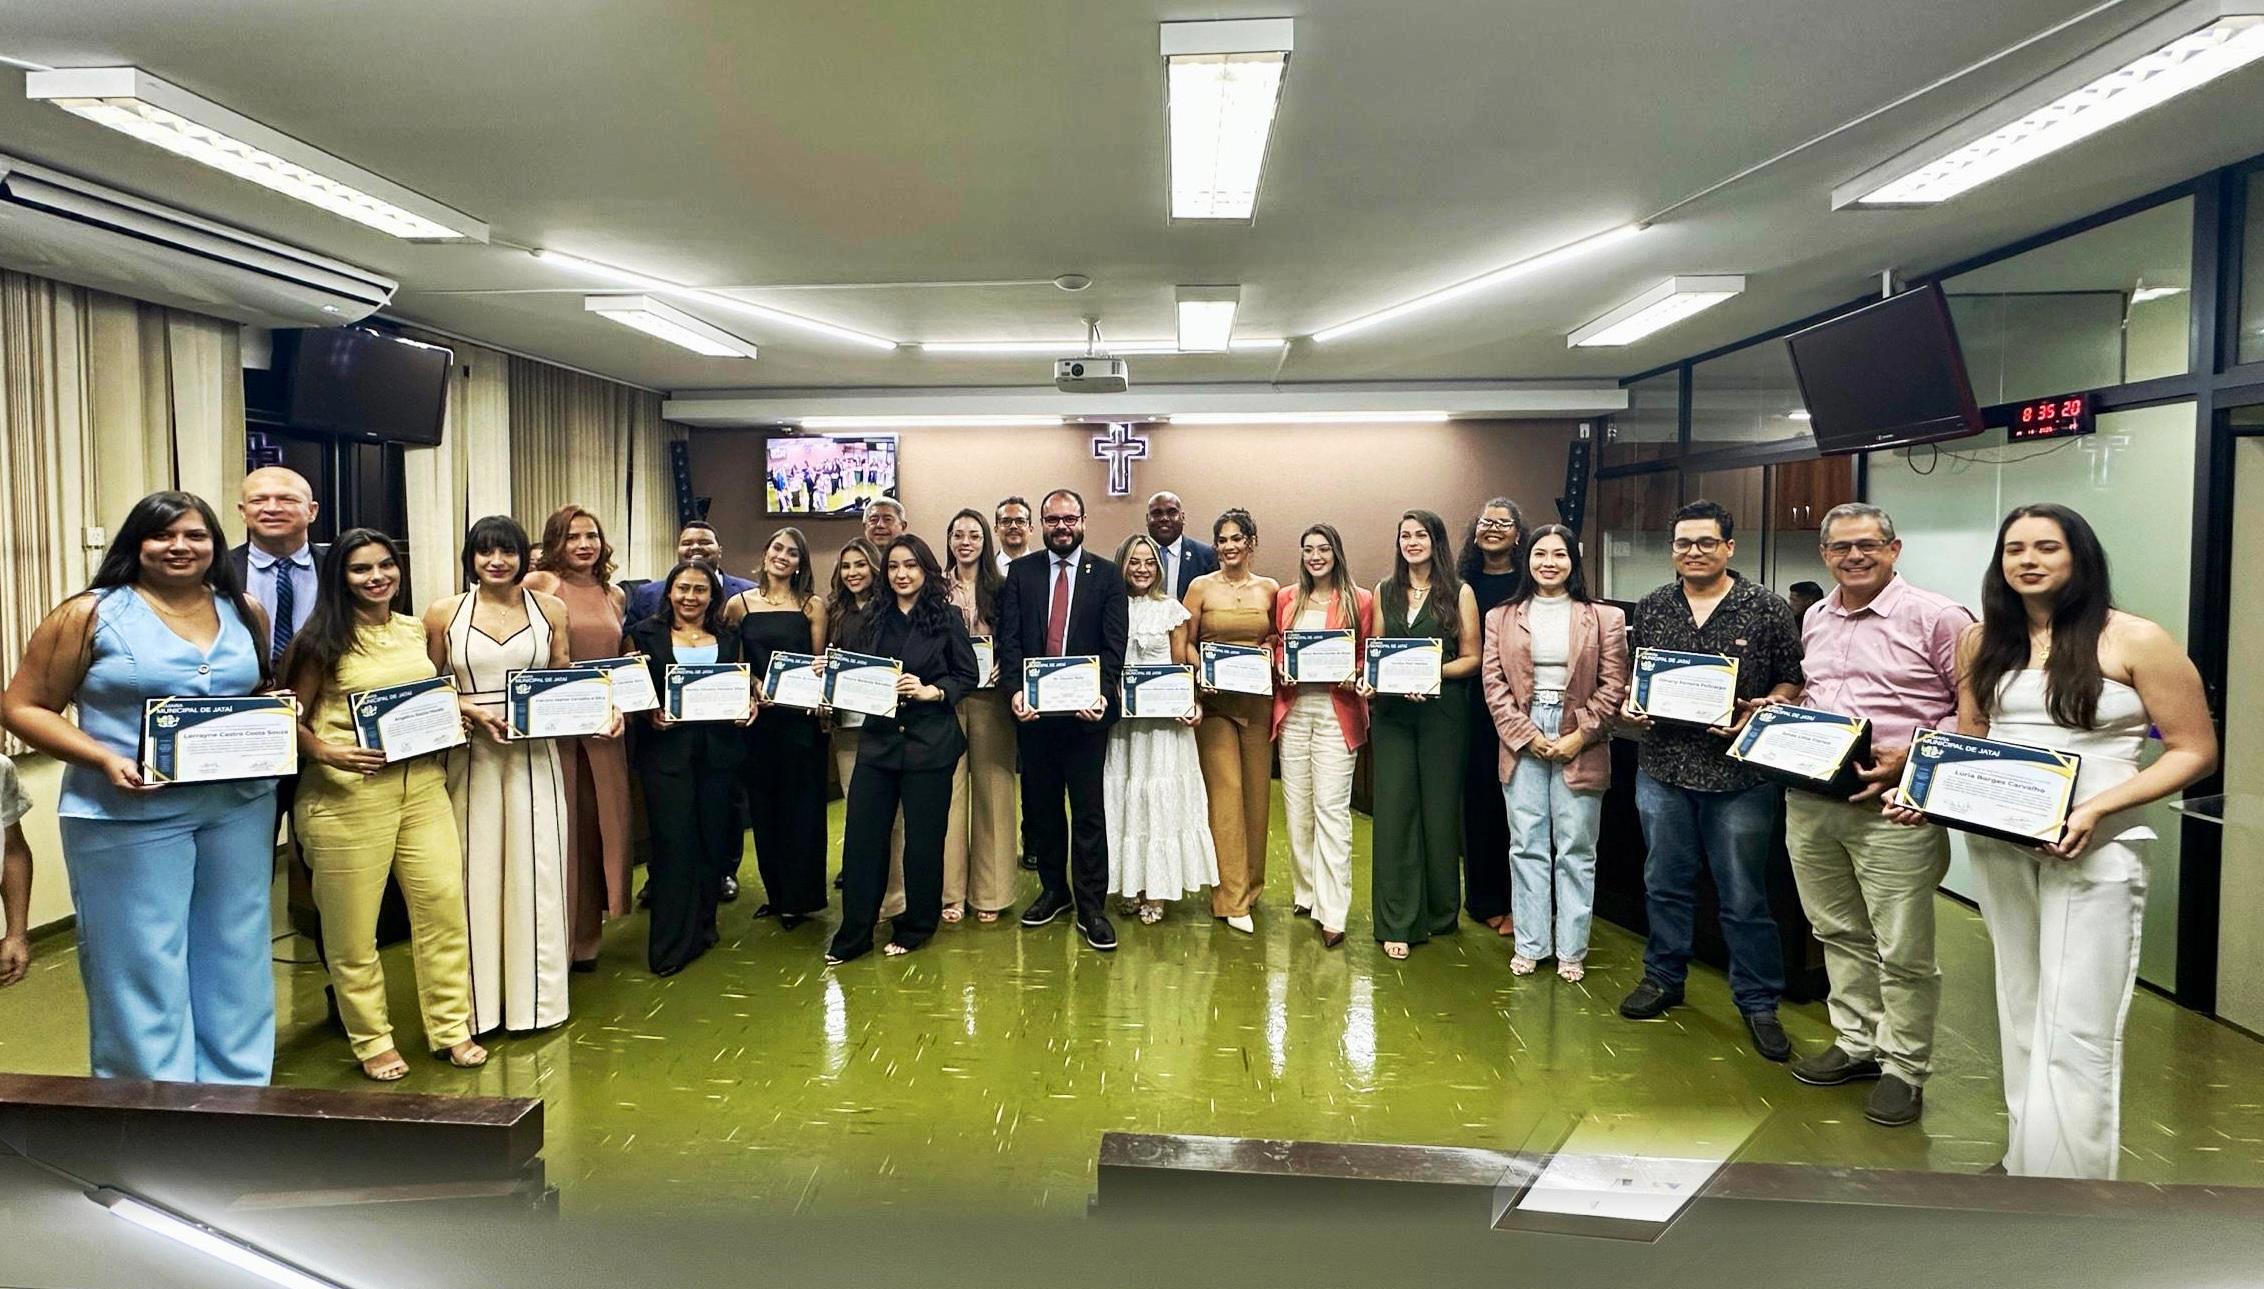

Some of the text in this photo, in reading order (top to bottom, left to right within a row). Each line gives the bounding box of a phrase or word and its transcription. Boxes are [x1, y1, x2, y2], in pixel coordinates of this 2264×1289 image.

[2023, 399, 2081, 422] 8 35 20
[157, 706, 198, 714] MUNICIPAL
[212, 705, 233, 713] JATAÍ
[1922, 738, 2001, 757] MUNICIPAL DE JATAÍ
[2007, 781, 2046, 794] Carvalho
